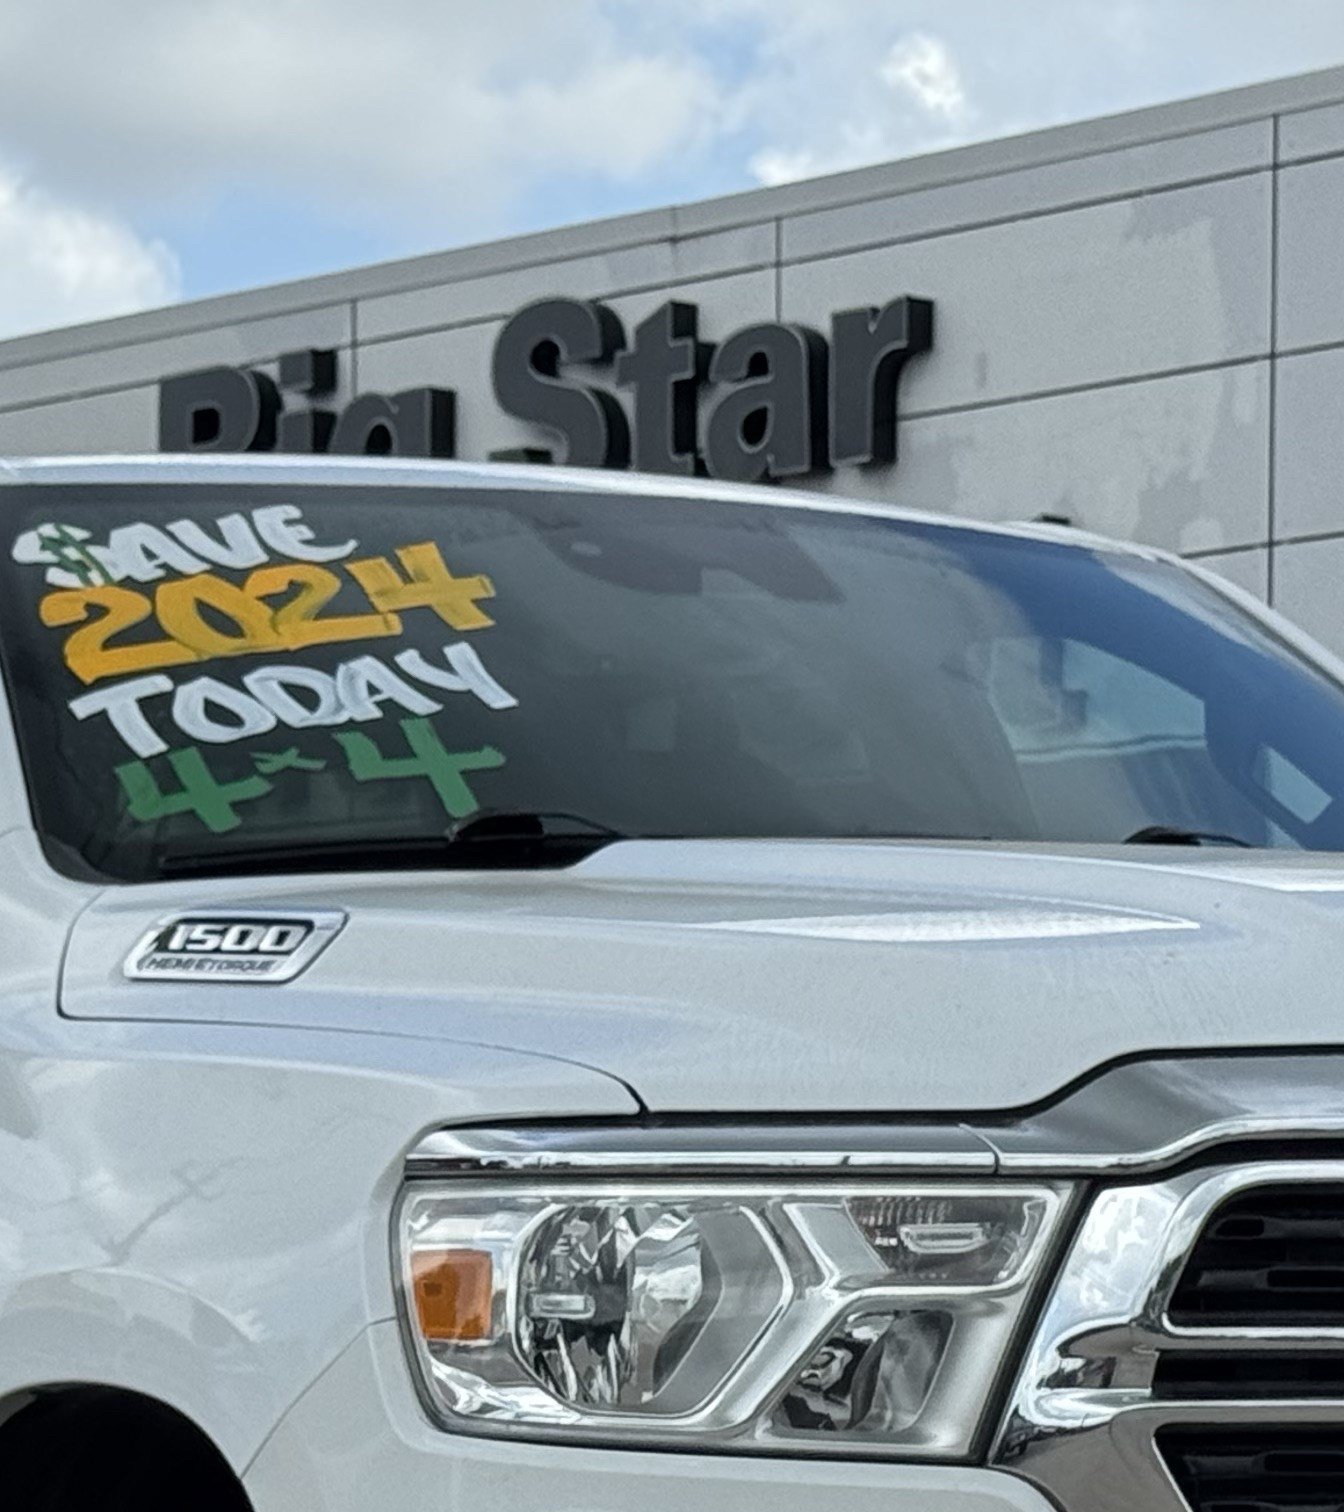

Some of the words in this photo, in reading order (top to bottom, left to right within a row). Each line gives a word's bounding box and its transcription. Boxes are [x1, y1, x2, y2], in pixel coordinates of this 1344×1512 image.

[493, 295, 934, 482] Star
[39, 541, 495, 684] 2024
[69, 642, 519, 758] TODAY
[167, 923, 305, 951] 1500
